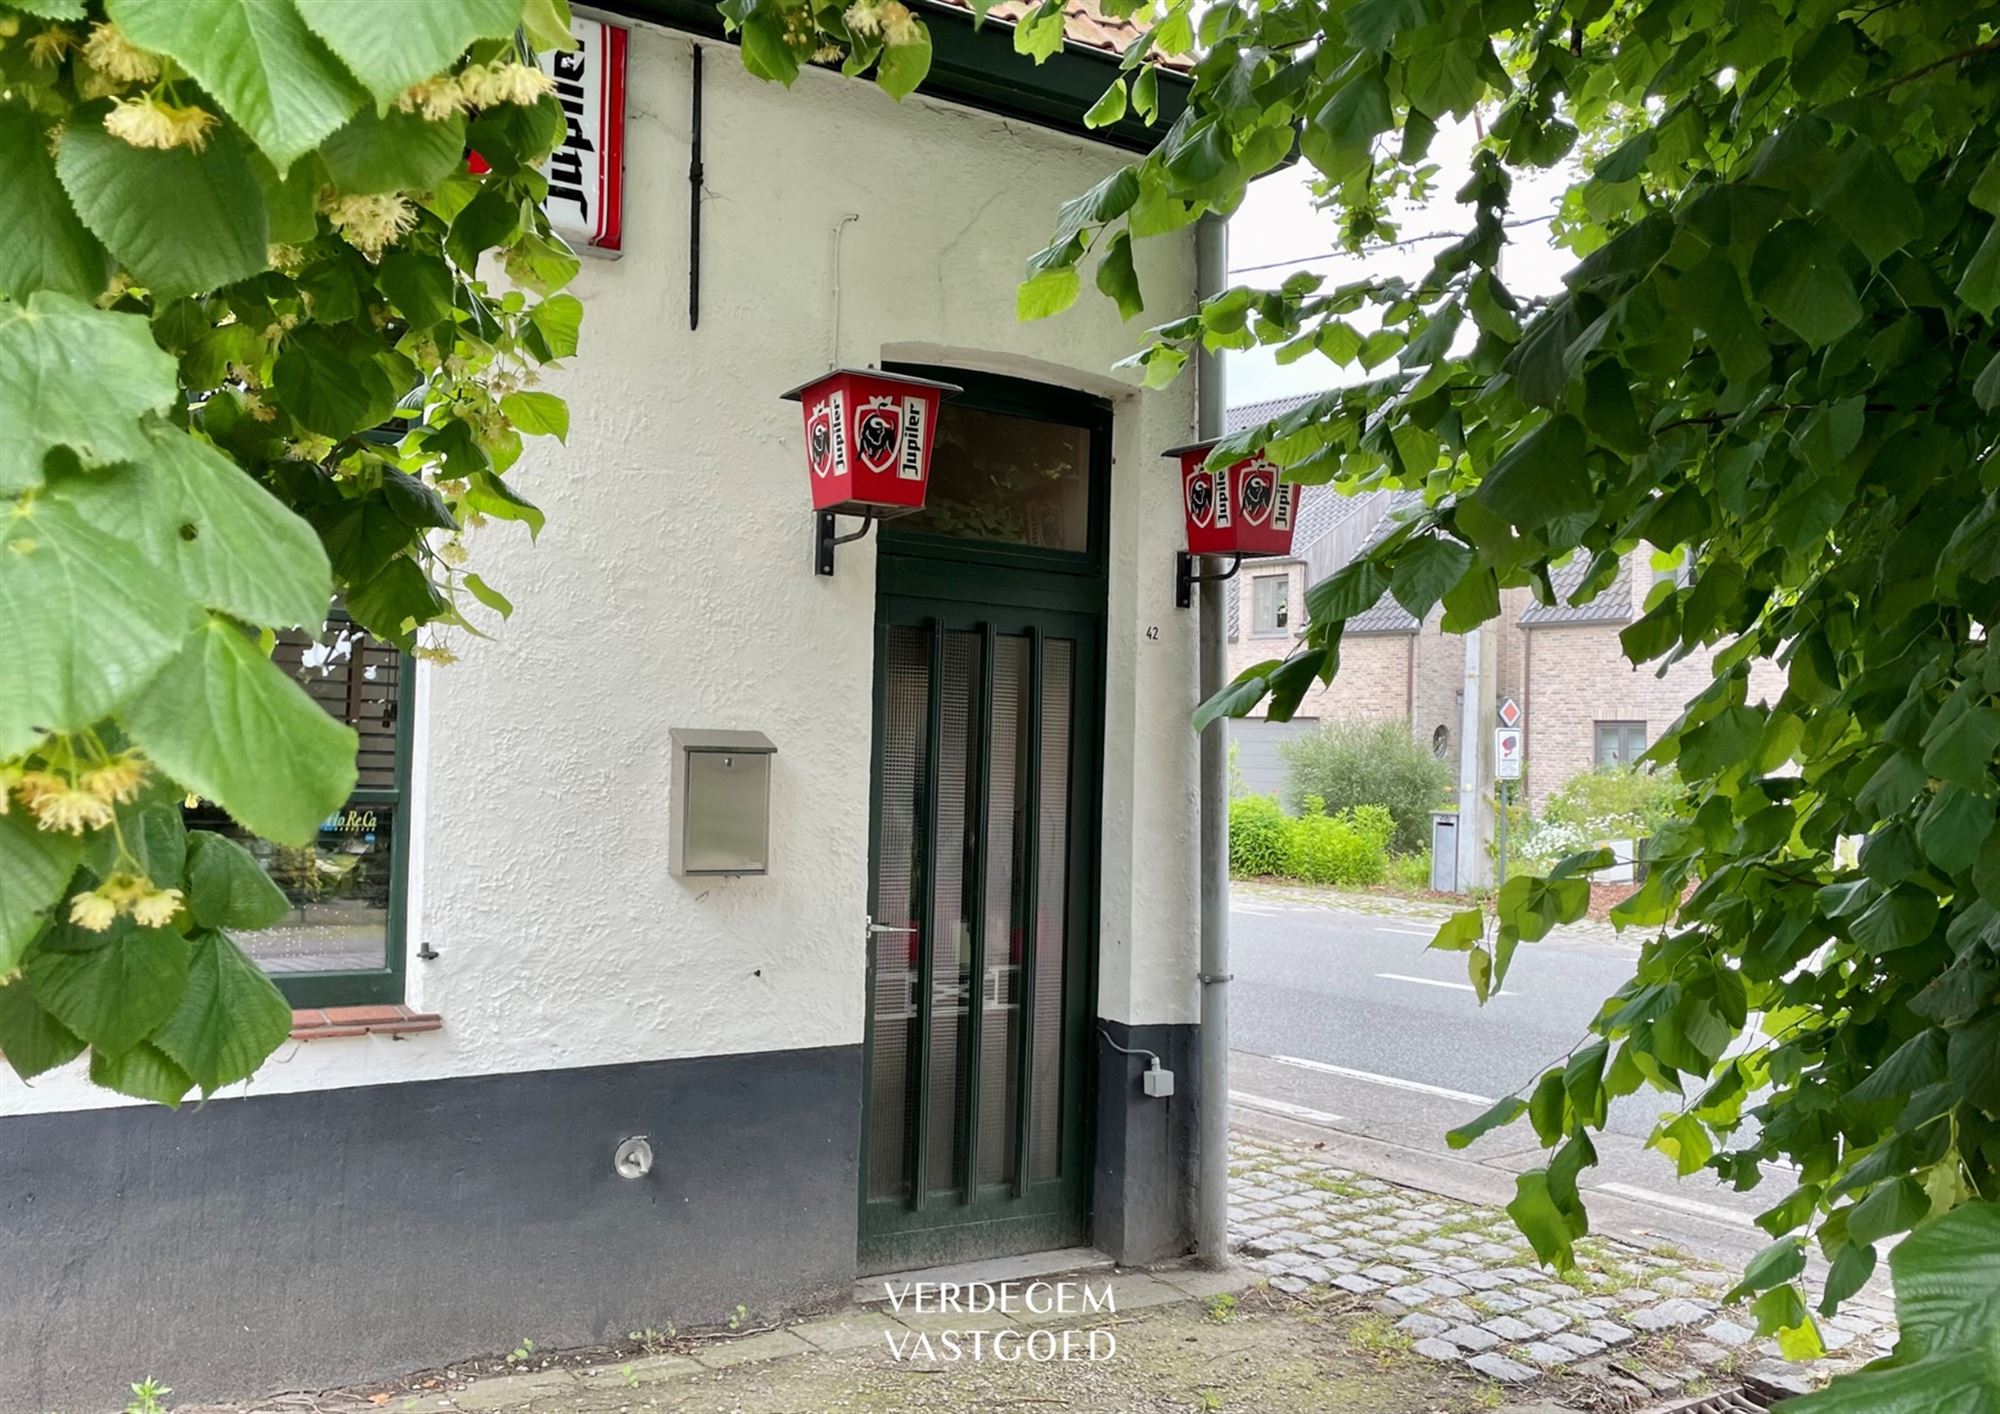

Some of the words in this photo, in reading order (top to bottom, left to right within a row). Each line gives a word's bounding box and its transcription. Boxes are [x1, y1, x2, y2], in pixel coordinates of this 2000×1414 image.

[833, 399, 845, 473] Jupiler
[902, 402, 921, 477] Jupiler
[1216, 471, 1229, 524] Jupile
[1274, 484, 1291, 529] Jupil
[1146, 626, 1159, 640] 42
